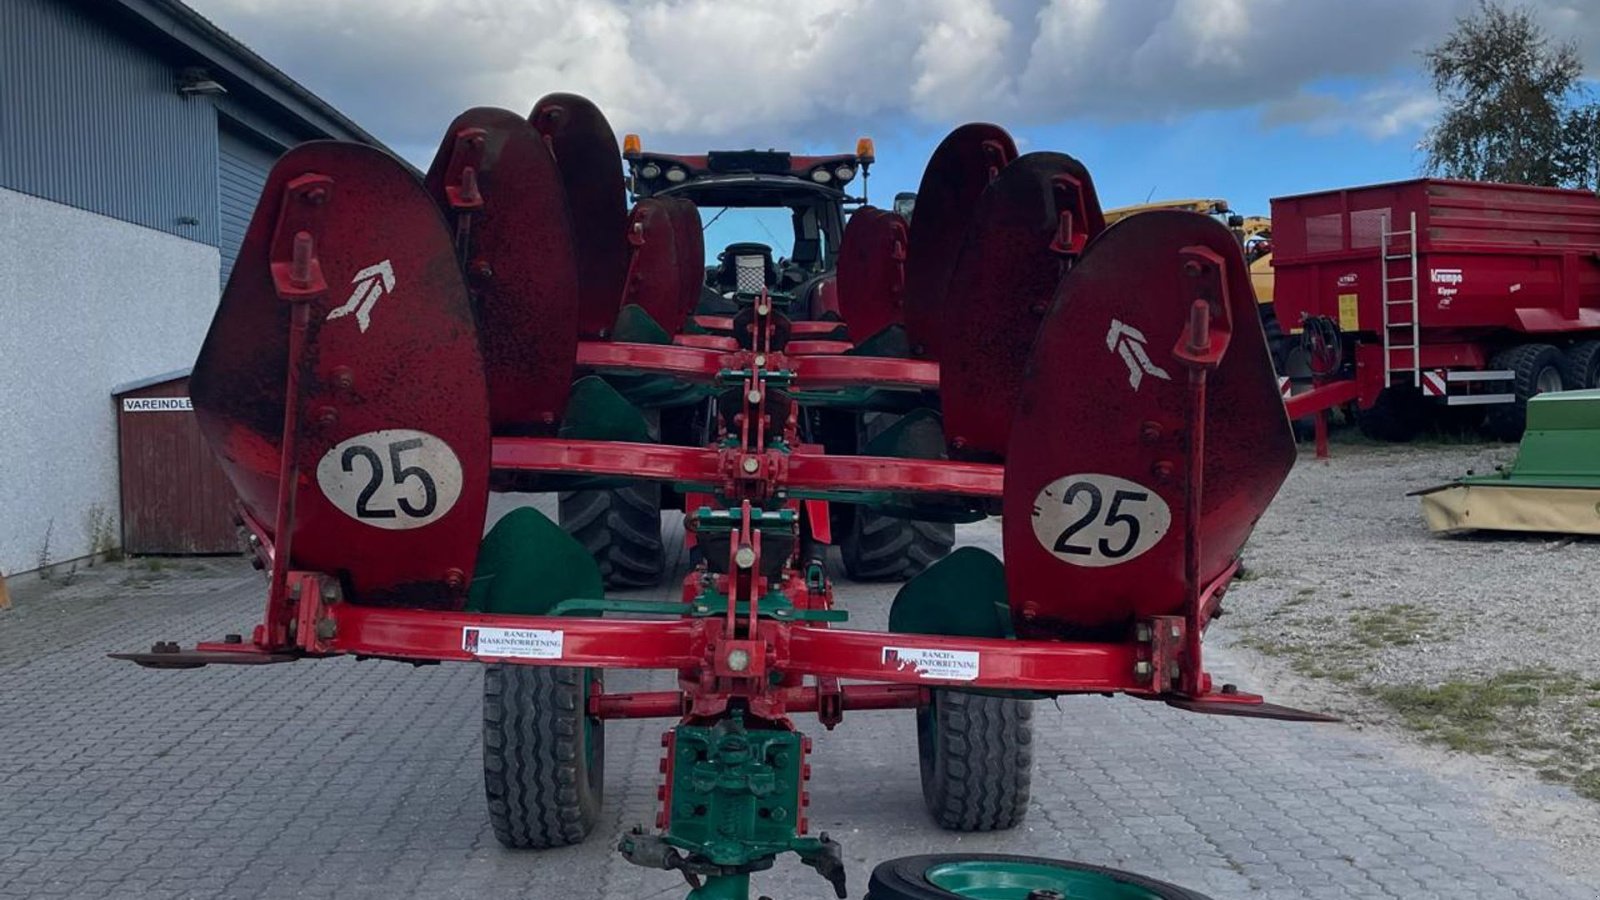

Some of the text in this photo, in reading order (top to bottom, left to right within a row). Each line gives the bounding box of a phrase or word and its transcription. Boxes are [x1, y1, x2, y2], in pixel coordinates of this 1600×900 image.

[341, 438, 437, 518] 25
[1054, 481, 1148, 558] 25
[480, 637, 560, 647] MASKINFORRETNING
